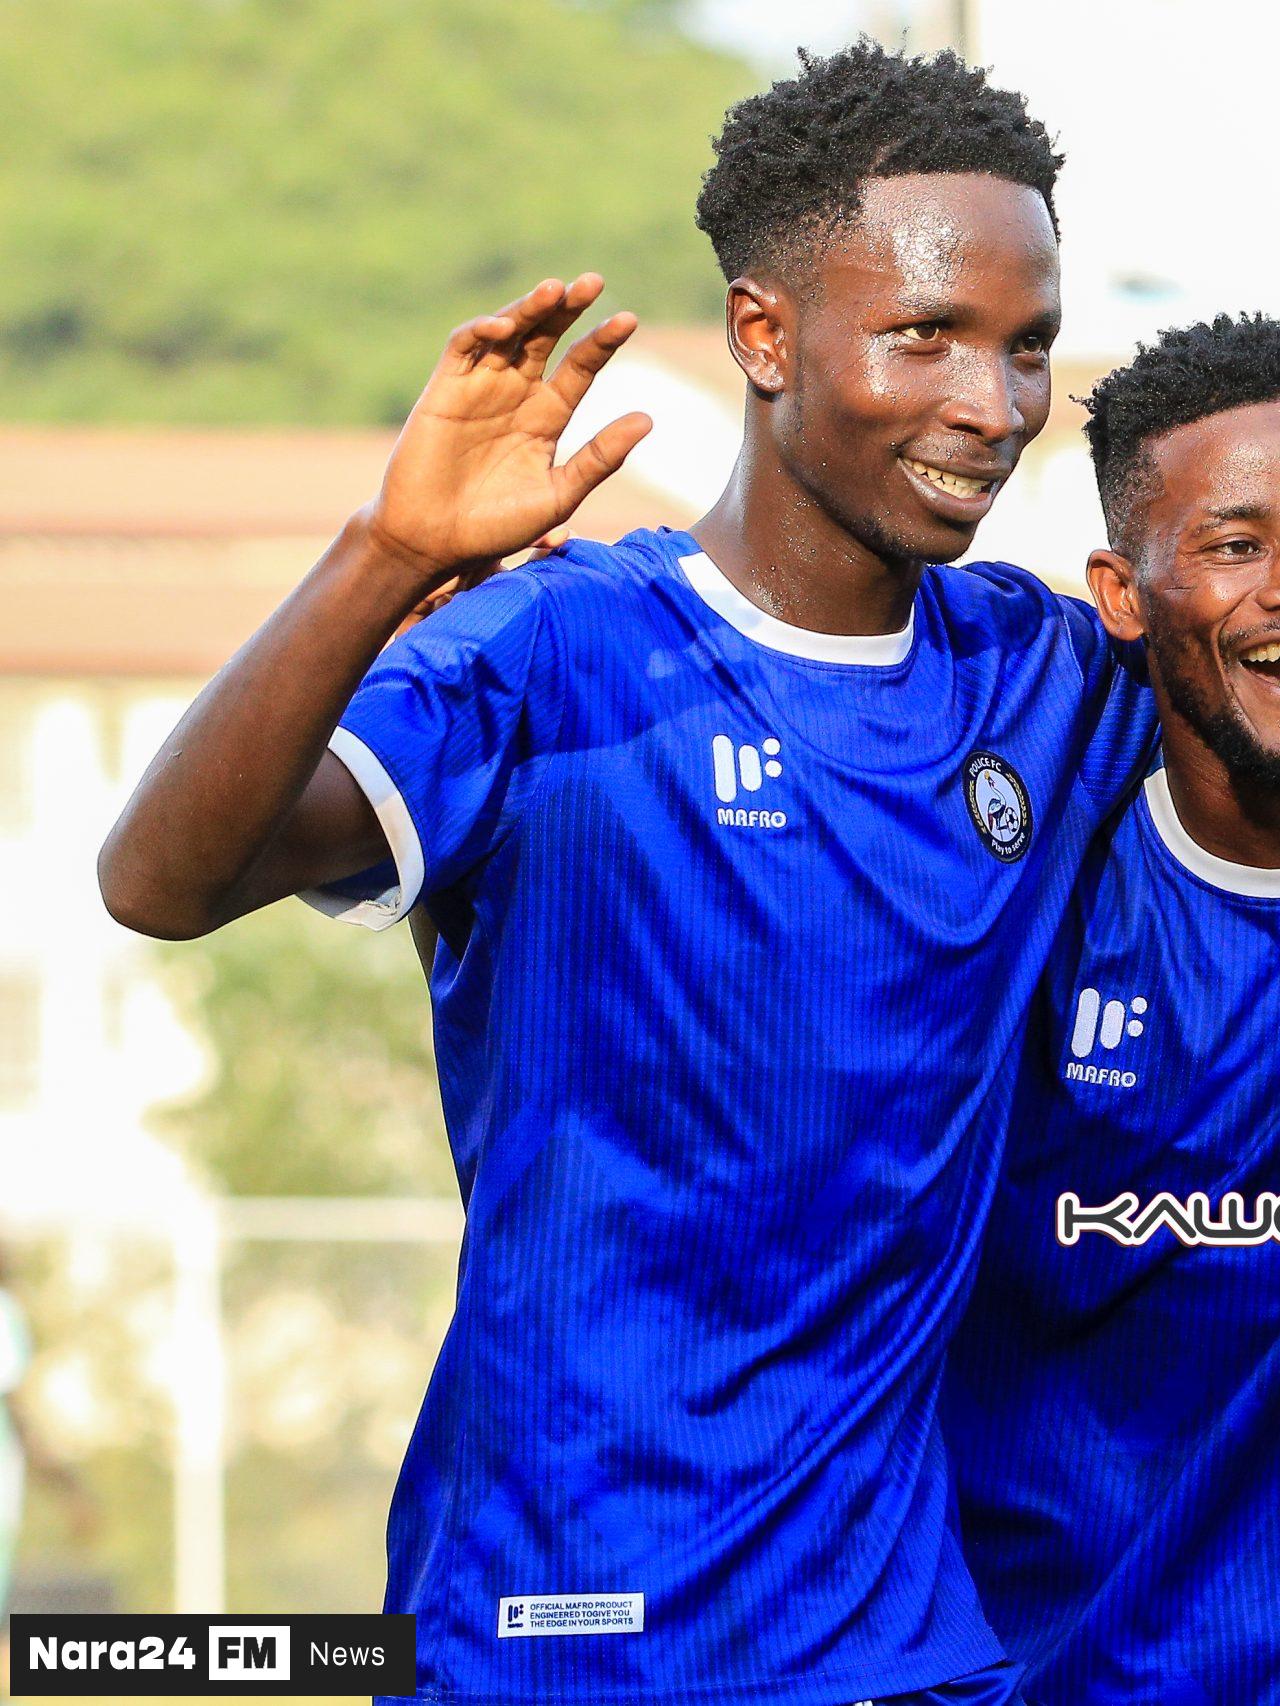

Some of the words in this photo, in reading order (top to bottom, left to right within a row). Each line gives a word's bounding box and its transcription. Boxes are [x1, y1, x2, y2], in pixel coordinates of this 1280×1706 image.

[969, 757, 990, 777] POLICE
[991, 759, 1001, 772] FC
[717, 808, 787, 828] MAFRO
[991, 839, 1005, 855] Play
[1005, 845, 1012, 854] to
[1012, 832, 1025, 852] serve
[1066, 1062, 1137, 1087] MAFRO
[530, 1611, 581, 1619] ENGINEERED
[601, 1617, 633, 1625] SPORTS
